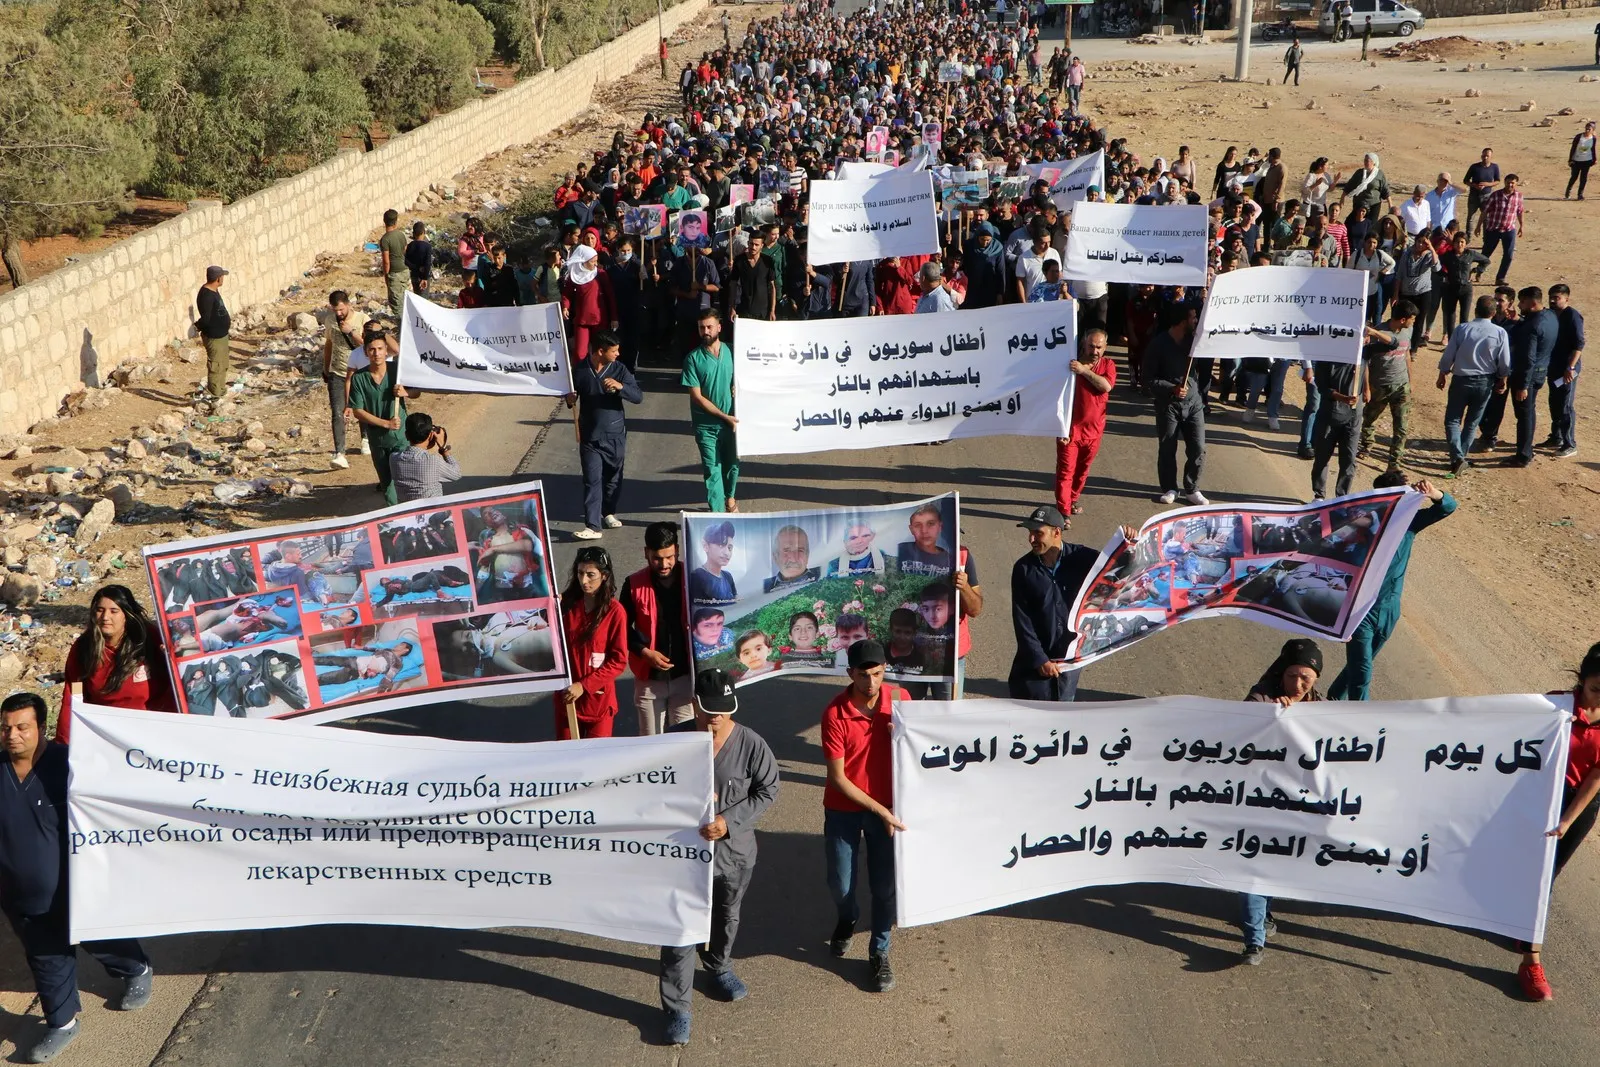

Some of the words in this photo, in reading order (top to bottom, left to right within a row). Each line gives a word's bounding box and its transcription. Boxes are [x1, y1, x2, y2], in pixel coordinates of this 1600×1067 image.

[907, 192, 931, 204] детям
[882, 223, 887, 232] و
[889, 217, 912, 231] السلام
[1091, 226, 1115, 235] осада
[1116, 226, 1151, 239] убивает
[1152, 229, 1180, 237] наших
[1182, 228, 1206, 238] детей
[1086, 248, 1118, 262] أطفالنا
[1120, 251, 1144, 265] يقتل
[1146, 251, 1184, 266] حصاركم
[1210, 294, 1240, 309] Пусть
[1242, 293, 1270, 305] дети
[1273, 293, 1316, 308] живут
[1319, 295, 1327, 304] в
[1330, 296, 1364, 310] мире
[415, 316, 448, 338] Пусть
[450, 333, 479, 345] дети
[483, 335, 517, 348] живут
[520, 334, 527, 343] в
[530, 330, 562, 344] мире
[939, 327, 986, 355] أطفال
[1043, 325, 1067, 350] كل
[1208, 324, 1240, 338] بسلام
[1244, 322, 1277, 335] تعيش
[1280, 322, 1324, 339] الطفولة
[1328, 324, 1354, 339] دعوا
[788, 341, 829, 365] دائرة
[835, 340, 851, 367] في
[868, 340, 933, 362] سوريون
[1007, 331, 1039, 355] يوم
[420, 350, 451, 366] بسلام
[534, 359, 560, 374] دعوا
[827, 373, 871, 397] بالنار
[877, 367, 981, 396] باستهدافهم
[910, 401, 956, 422] الدواء
[1007, 391, 1022, 414] أو
[791, 408, 852, 432] والحصار
[857, 405, 904, 430] عنهم
[919, 735, 998, 773] الموت
[1008, 729, 1089, 765] دائرة
[1100, 727, 1132, 767] في
[1162, 737, 1287, 766] سوريون
[1298, 727, 1387, 771] أطفال
[1424, 741, 1484, 773] يوم
[1494, 738, 1545, 774] كل
[125, 748, 225, 783] Смерть
[252, 768, 409, 797] неизбежная
[417, 774, 501, 803] судьба
[1074, 776, 1158, 810] بالنار
[1169, 778, 1362, 821] باستهدافهم
[476, 808, 597, 829] обстрела
[71, 823, 224, 855] раждебной
[231, 826, 312, 846] осады
[321, 825, 371, 842] или
[380, 827, 601, 852] предотвращения
[610, 839, 713, 864] поставо
[1001, 825, 1113, 868] والحصار
[1124, 825, 1208, 857] عنهم
[1218, 829, 1306, 859] الدواء
[1314, 841, 1391, 874] بمنع
[1396, 833, 1430, 877] أو
[247, 864, 447, 886] лекарственных
[454, 866, 553, 889] средств
